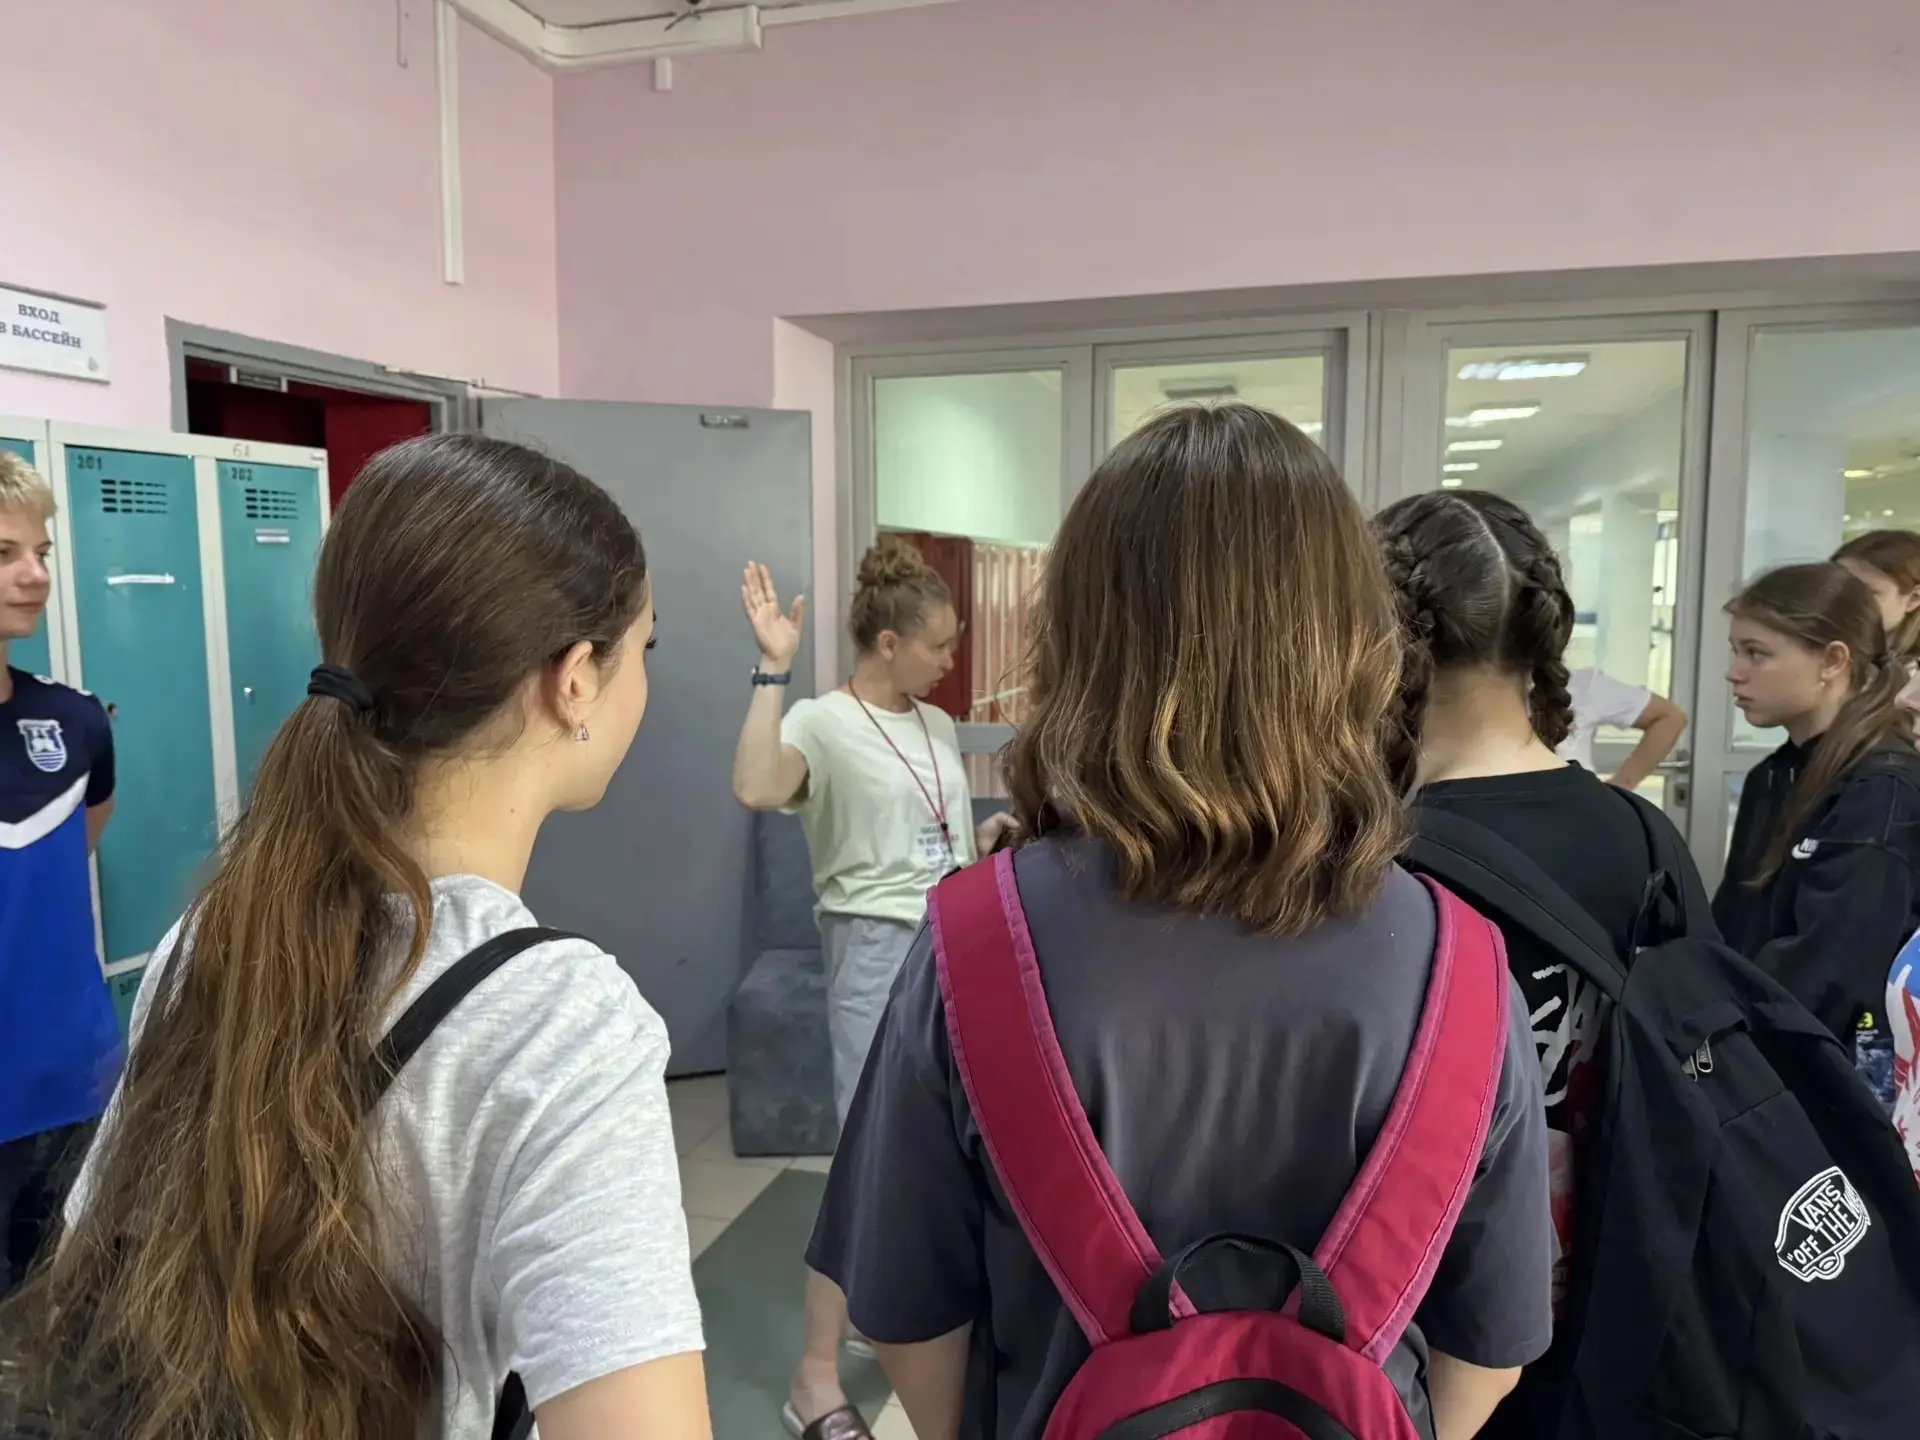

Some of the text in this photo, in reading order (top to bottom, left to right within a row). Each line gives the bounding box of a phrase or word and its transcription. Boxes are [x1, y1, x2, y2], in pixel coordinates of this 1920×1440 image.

[17, 303, 61, 324] ВХОД
[12, 324, 81, 349] БАССЕЙН
[1790, 1178, 1842, 1231] VANS
[1814, 1203, 1856, 1245] THE
